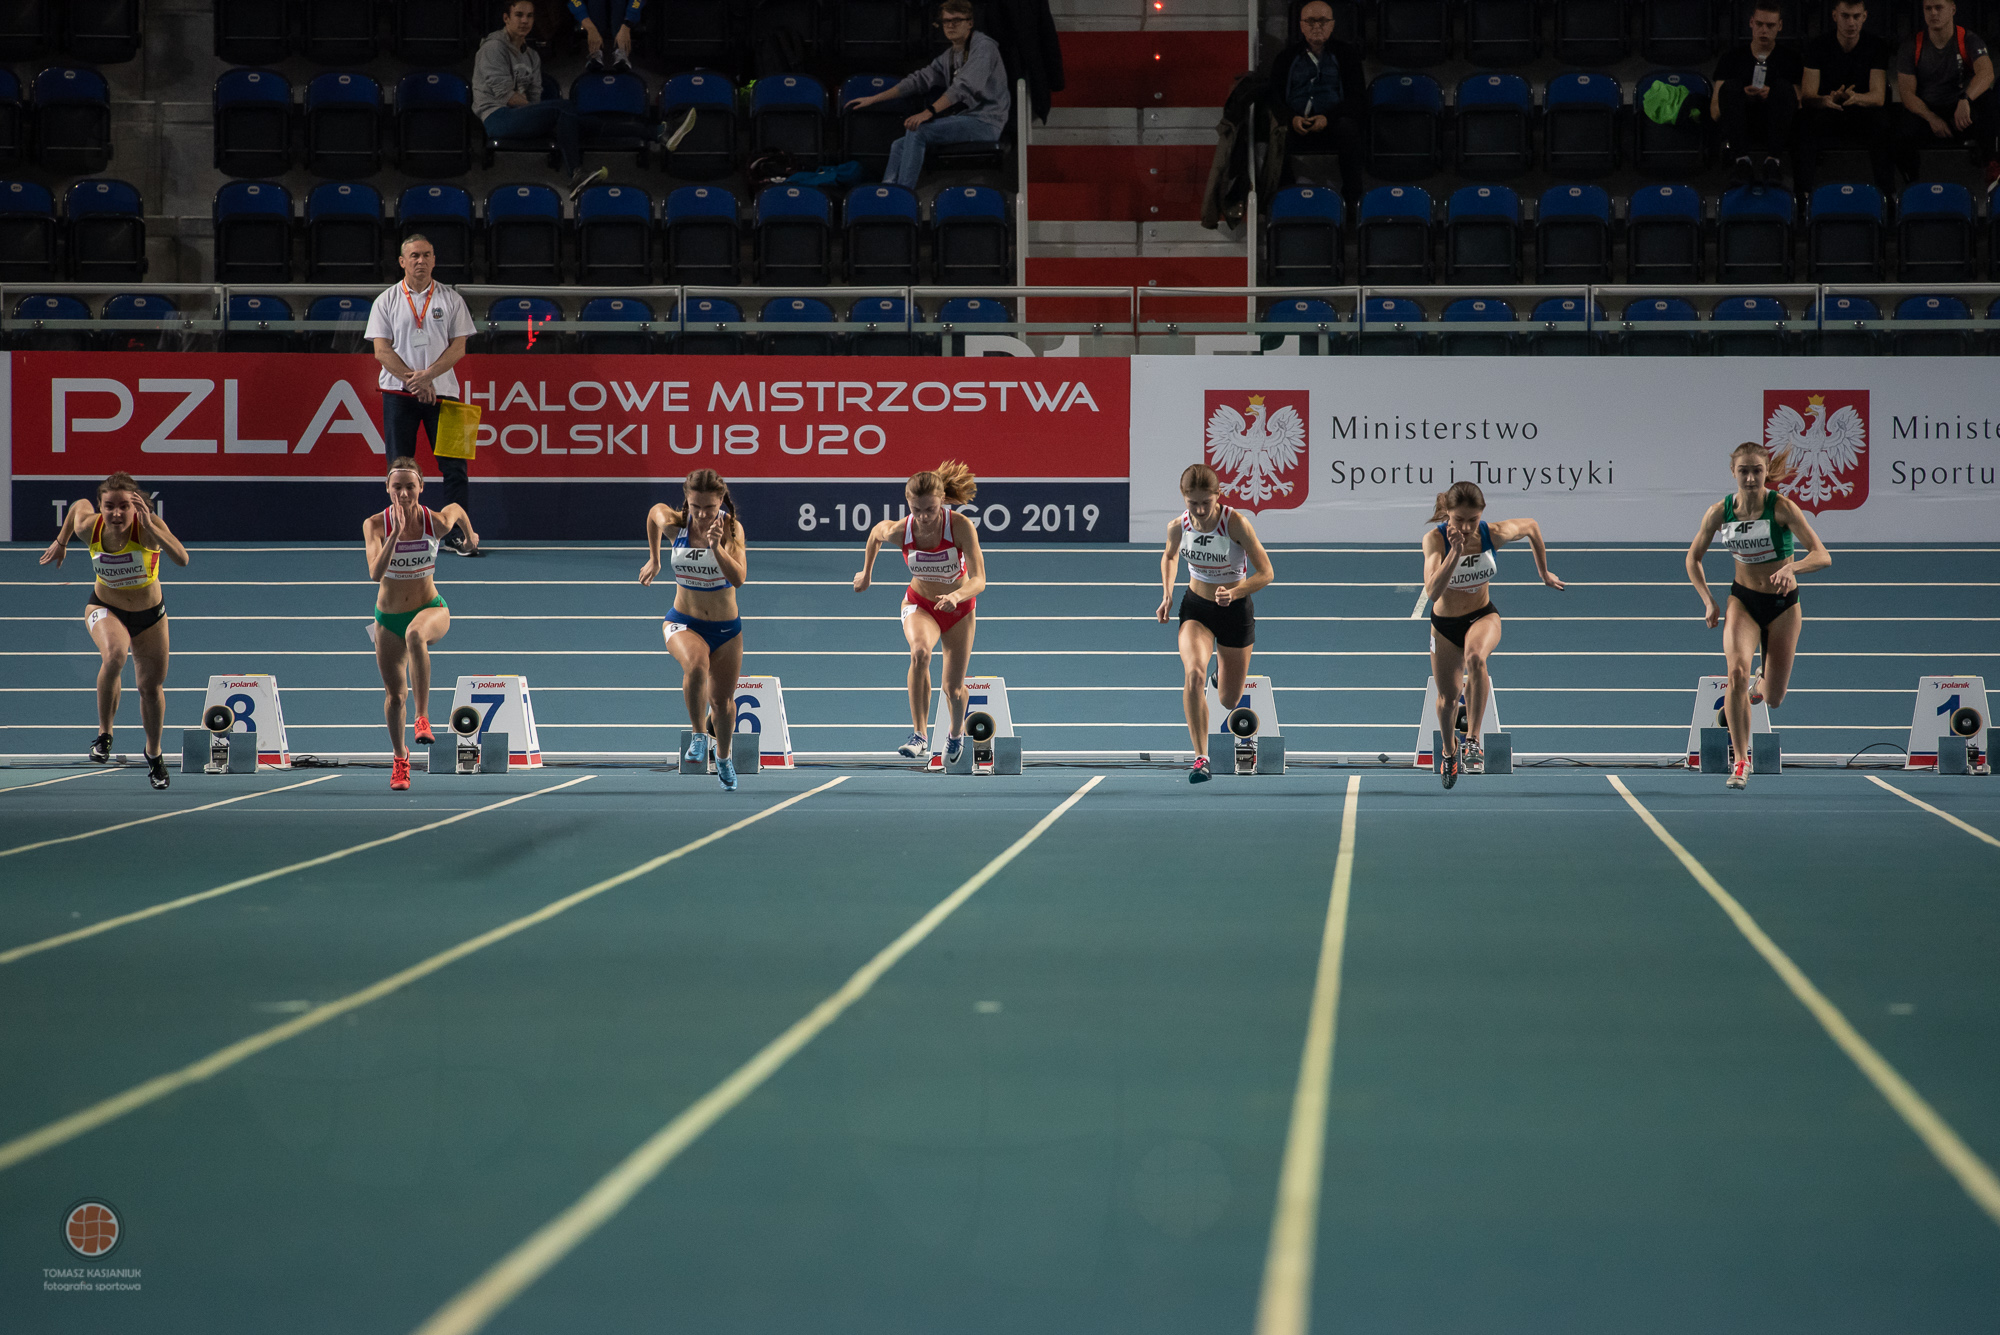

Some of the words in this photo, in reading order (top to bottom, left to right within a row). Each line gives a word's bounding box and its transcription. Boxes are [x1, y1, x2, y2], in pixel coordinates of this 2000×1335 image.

[464, 381, 690, 412] HALOWE
[707, 381, 1100, 412] MISTRZOSTWA
[52, 378, 387, 454] PZLA
[1331, 415, 1538, 439] Ministerstwo
[464, 424, 648, 455] POLSKI
[669, 424, 760, 455] U18
[779, 424, 886, 455] U20
[1331, 460, 1434, 490] Sportu
[1449, 460, 1455, 484] i
[1470, 460, 1614, 491] Turystyki
[1892, 460, 1996, 491] Sportu
[798, 503, 872, 532] 8-10
[1021, 503, 1100, 532] 2019
[390, 556, 431, 567] ROLSKA
[675, 565, 719, 575] STRUZIK
[1180, 548, 1228, 563] SKRZYPNIK
[95, 565, 144, 577] MASZKIEWICZ
[230, 681, 259, 689] polanik
[477, 681, 507, 689] polanik
[1940, 682, 1970, 690] polanik
[225, 693, 257, 740] 8
[471, 694, 505, 744] 7
[734, 694, 761, 733] 6
